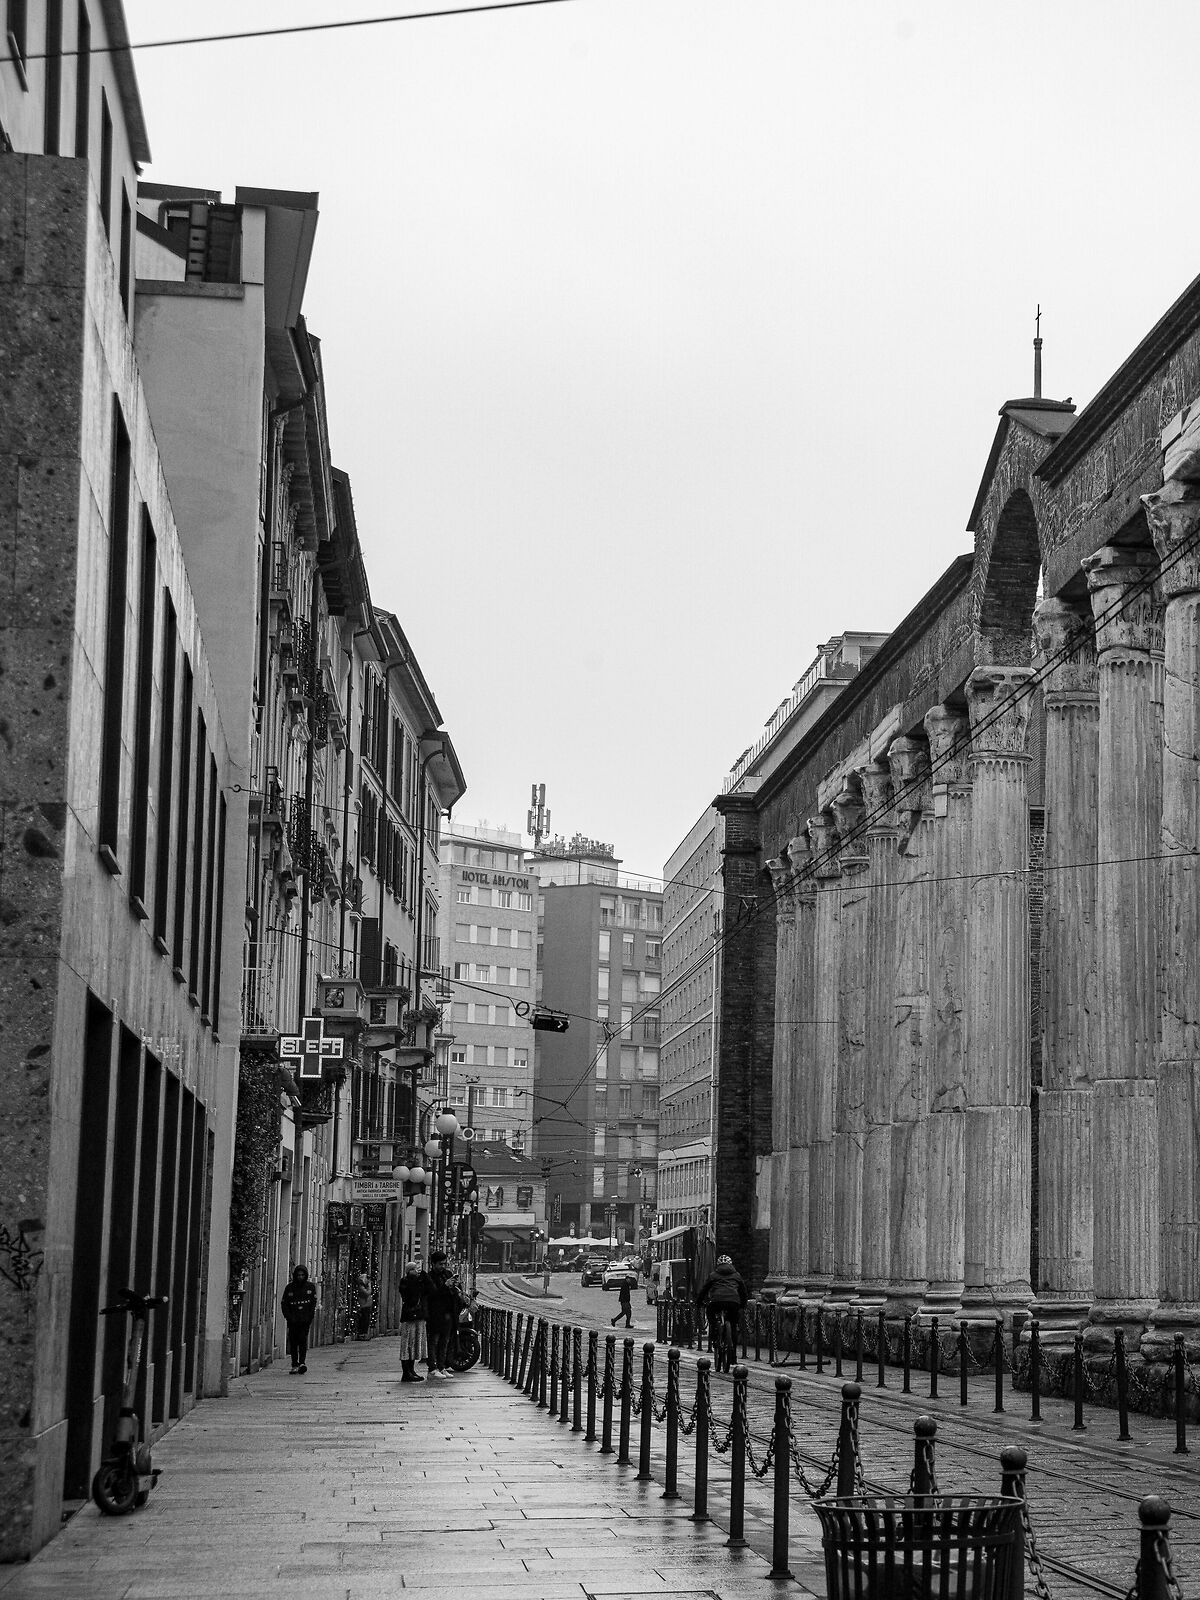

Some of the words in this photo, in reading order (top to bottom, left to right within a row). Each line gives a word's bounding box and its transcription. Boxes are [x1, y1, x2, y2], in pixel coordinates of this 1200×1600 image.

[462, 870, 490, 885] HOTEL
[493, 874, 529, 890] ARISTON
[354, 1181, 374, 1189] TIMBRI
[379, 1181, 400, 1189] TARGHE
